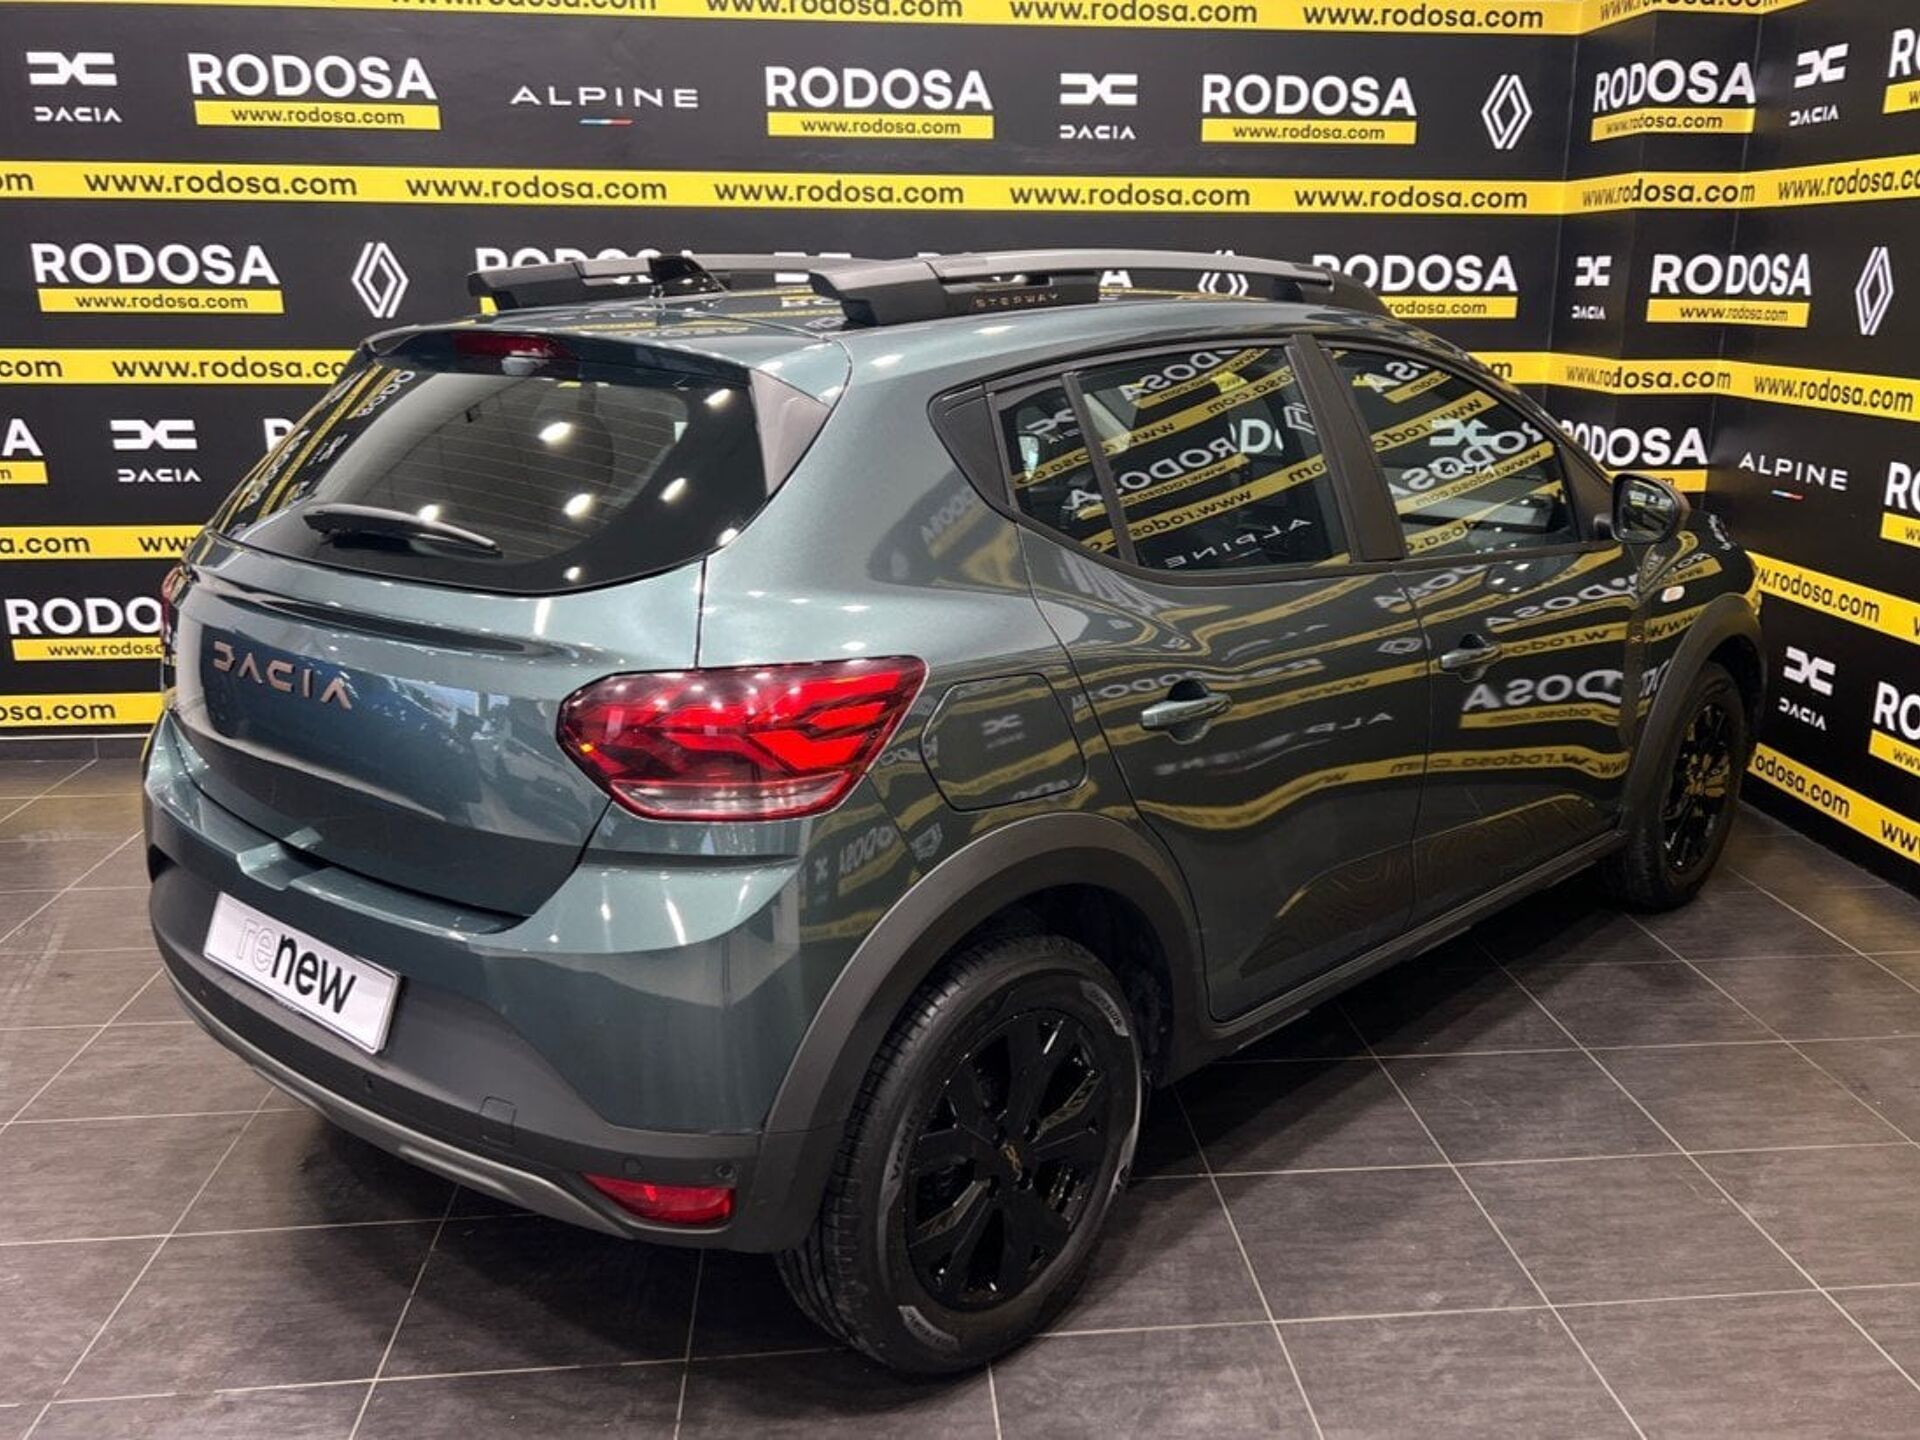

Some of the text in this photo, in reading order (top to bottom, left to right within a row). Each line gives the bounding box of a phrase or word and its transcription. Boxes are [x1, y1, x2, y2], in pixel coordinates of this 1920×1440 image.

[1011, 0, 1257, 23] www.rodosa.com
[1304, 3, 1543, 29] www.rodosa.com
[188, 53, 437, 99] RODOSA
[765, 66, 993, 111] RODOSA
[1593, 59, 1756, 113] RODOSA
[510, 86, 699, 108] ALPINE
[1201, 74, 1416, 116] RODOSA
[34, 106, 122, 122] DACIA
[232, 106, 405, 126] www.rodosa.com
[801, 117, 961, 136] www.rodosa.com
[1606, 109, 1723, 134] www.rodosa.com
[1789, 104, 1839, 126] DACIA
[1060, 125, 1135, 140] DACIA
[1233, 123, 1385, 141] www.rodosa.com
[84, 170, 357, 195] www.rodosa.com
[406, 174, 667, 200] www.rodosa.com
[714, 180, 964, 205] www.rodosa.com
[1011, 182, 1251, 207] www.rodosa.com
[1582, 179, 1755, 206] www.rodosa.com
[1294, 186, 1528, 209] www.rodosa.com
[31, 243, 279, 284] RODOSA
[1650, 253, 1812, 297] RODOSA
[75, 293, 248, 310] www.rodosa.com
[1679, 304, 1788, 323] www.rodosa.com
[1566, 364, 1731, 390] www.rodosa.com
[1754, 374, 1913, 413] www.rodosa.com
[117, 469, 202, 483] DACIA
[1739, 452, 1849, 492] ALPINE
[213, 640, 352, 711] DACIA
[1777, 697, 1827, 732] DACIA
[236, 917, 356, 1014] renew
